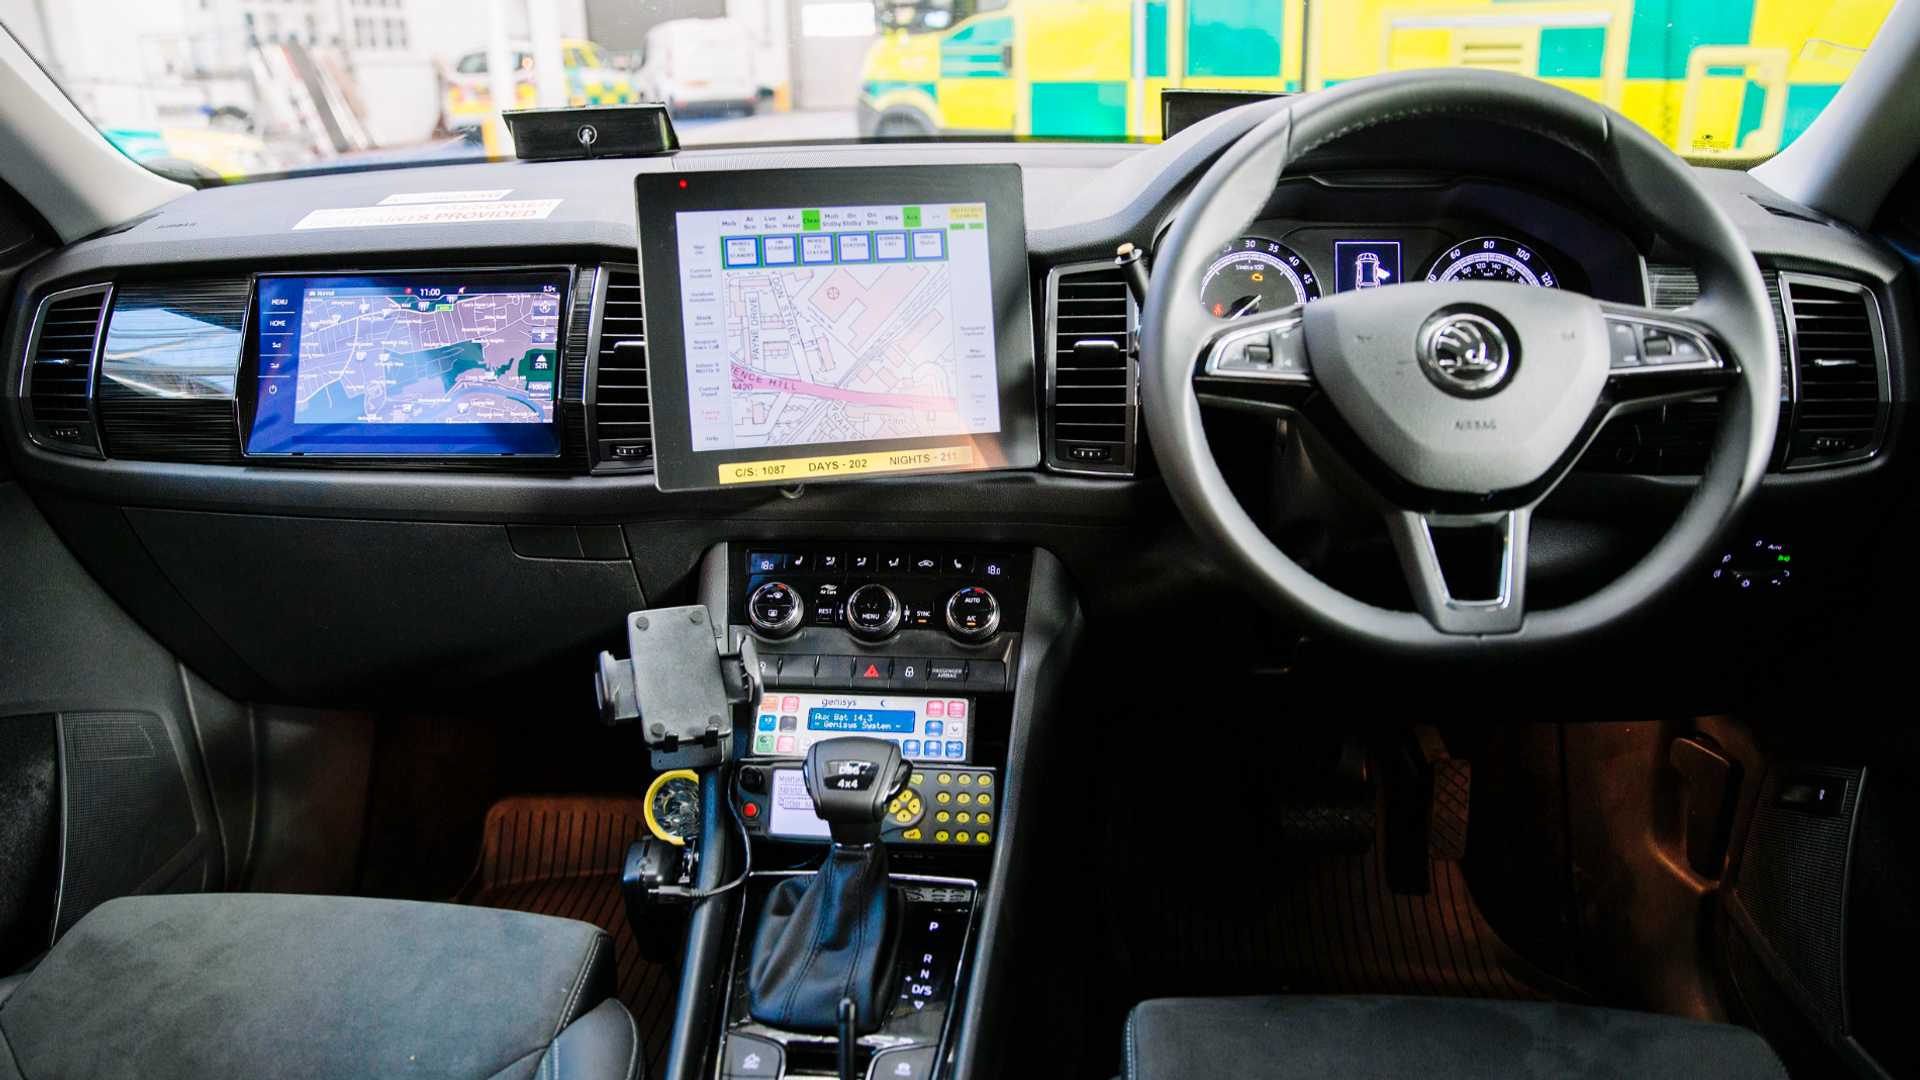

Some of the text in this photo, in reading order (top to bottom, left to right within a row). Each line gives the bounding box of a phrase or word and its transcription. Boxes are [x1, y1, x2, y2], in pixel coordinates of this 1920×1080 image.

[434, 209, 537, 221] PROVIDED
[1245, 240, 1257, 248] 30
[1268, 243, 1280, 253] 35
[1483, 240, 1495, 249] 80
[1450, 248, 1462, 260] 60
[1515, 247, 1531, 261] 100
[1288, 255, 1300, 267] 40
[1303, 273, 1313, 285] 45
[1540, 272, 1554, 288] 120
[420, 288, 441, 297] 11:00
[749, 296, 759, 327] DRIVE
[768, 378, 798, 391] HILL
[808, 460, 840, 473] DAYS
[848, 458, 868, 470] 202
[889, 454, 931, 466] NIGHTS
[735, 464, 787, 478] C/S: 1087
[965, 596, 981, 604] AUTO
[862, 612, 880, 621] MENU
[916, 609, 931, 617] SYNC
[814, 713, 829, 721] Aux
[837, 779, 858, 789] 4x4
[929, 921, 939, 931] P
[923, 953, 933, 964] R
[920, 969, 930, 979] N
[911, 984, 933, 996] D/S
